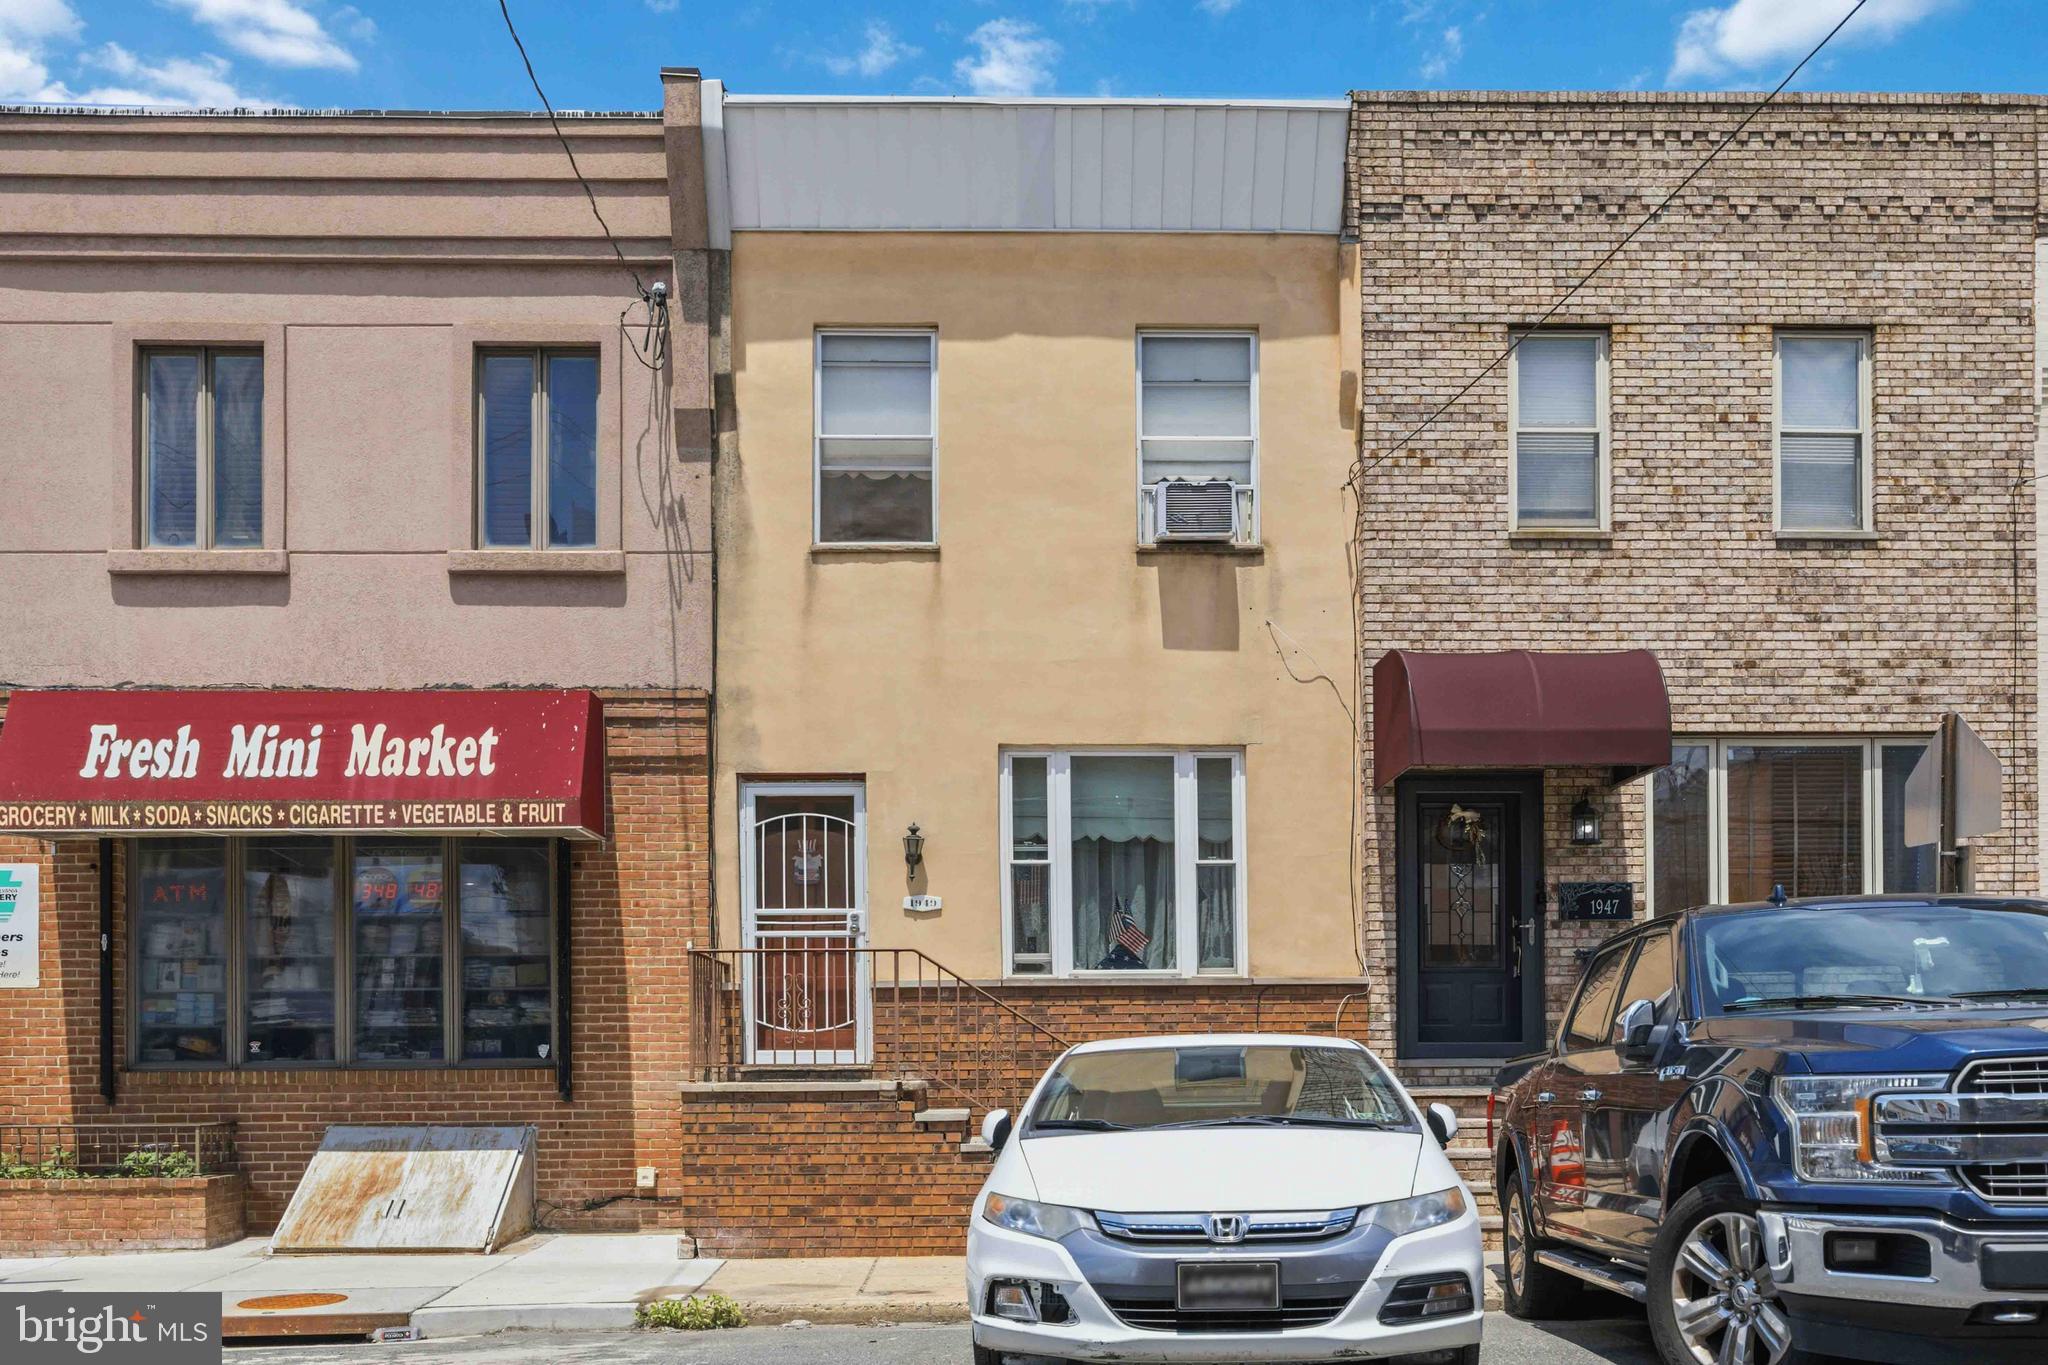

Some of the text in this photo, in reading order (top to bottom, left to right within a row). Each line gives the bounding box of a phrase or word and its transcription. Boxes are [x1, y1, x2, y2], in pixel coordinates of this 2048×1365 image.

[79, 723, 499, 779] Fresh Mini Market
[0, 803, 566, 827] GROCERY MILK SODA SNACKS CIGARETTE VEGETABLE & FRUIT
[152, 884, 208, 903] ATM
[1590, 899, 1619, 914] 1947
[0, 933, 24, 942] ers
